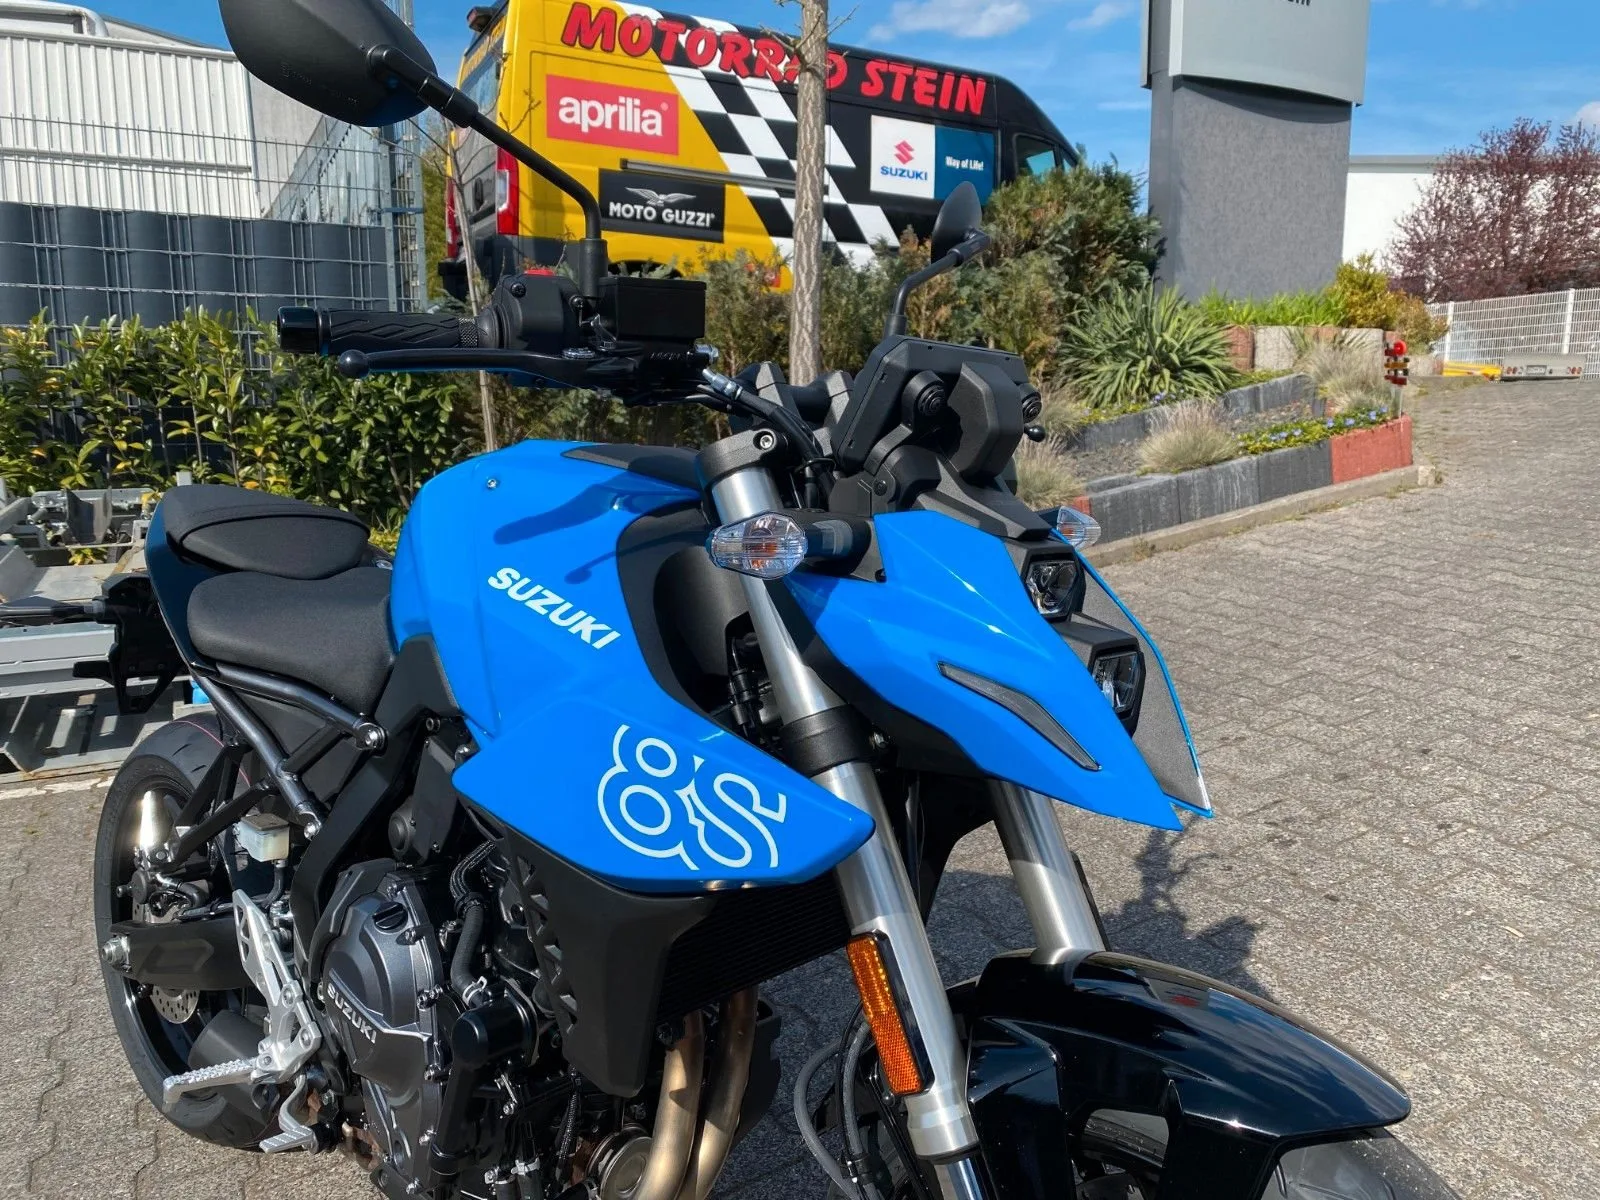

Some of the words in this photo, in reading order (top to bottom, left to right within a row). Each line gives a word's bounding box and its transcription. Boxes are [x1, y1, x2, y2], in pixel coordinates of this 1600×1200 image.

[860, 59, 987, 116] STEIN
[558, 95, 663, 137] aprilia
[880, 165, 928, 181] SUZUKI
[945, 155, 960, 169] Way
[961, 158, 969, 169] of
[608, 201, 657, 221] MOTO
[662, 208, 711, 227] GUZZI
[487, 566, 622, 650] SUZUKI
[327, 982, 377, 1044] SUZUKI
